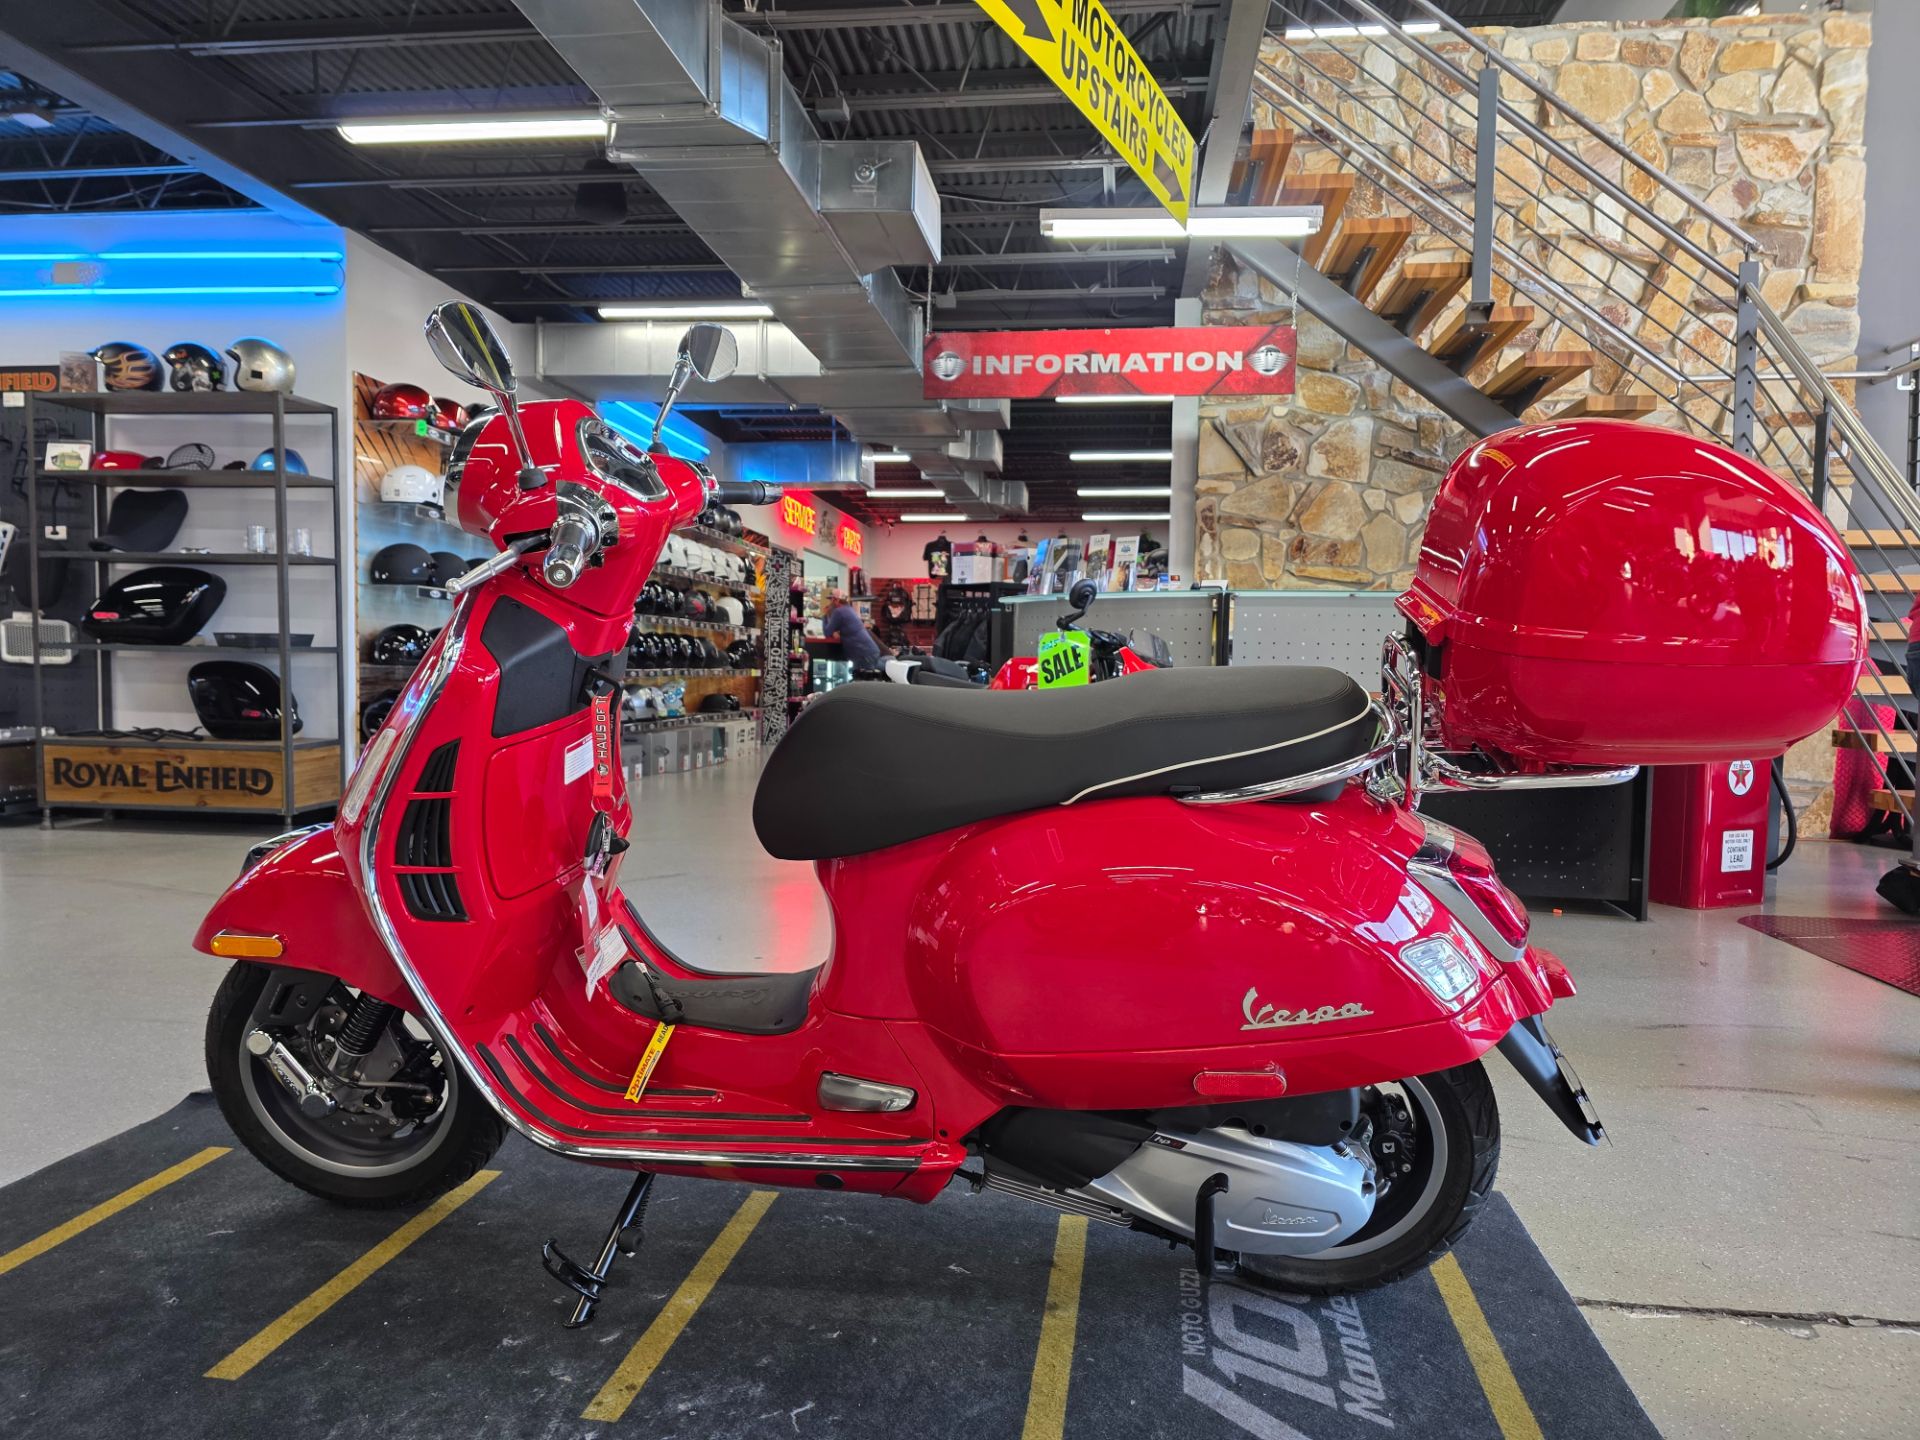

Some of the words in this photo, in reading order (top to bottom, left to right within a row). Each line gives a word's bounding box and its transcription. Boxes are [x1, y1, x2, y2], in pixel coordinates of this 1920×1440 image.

[1061, 28, 1148, 166] UPSTAIRS
[1072, 0, 1186, 167] MOTORCYCLES
[972, 351, 1243, 376] INFORMATION
[784, 496, 816, 535] SERVICE
[1041, 645, 1084, 684] SALE
[596, 707, 606, 722] OF
[595, 724, 608, 758] HAUS
[53, 757, 147, 788] ROYAL
[155, 761, 274, 795] ENFIELD
[1240, 986, 1374, 1030] Vespa
[1262, 1207, 1318, 1224] Vespa
[1179, 1267, 1201, 1309] GUZZI
[1181, 1312, 1206, 1356] MOTO
